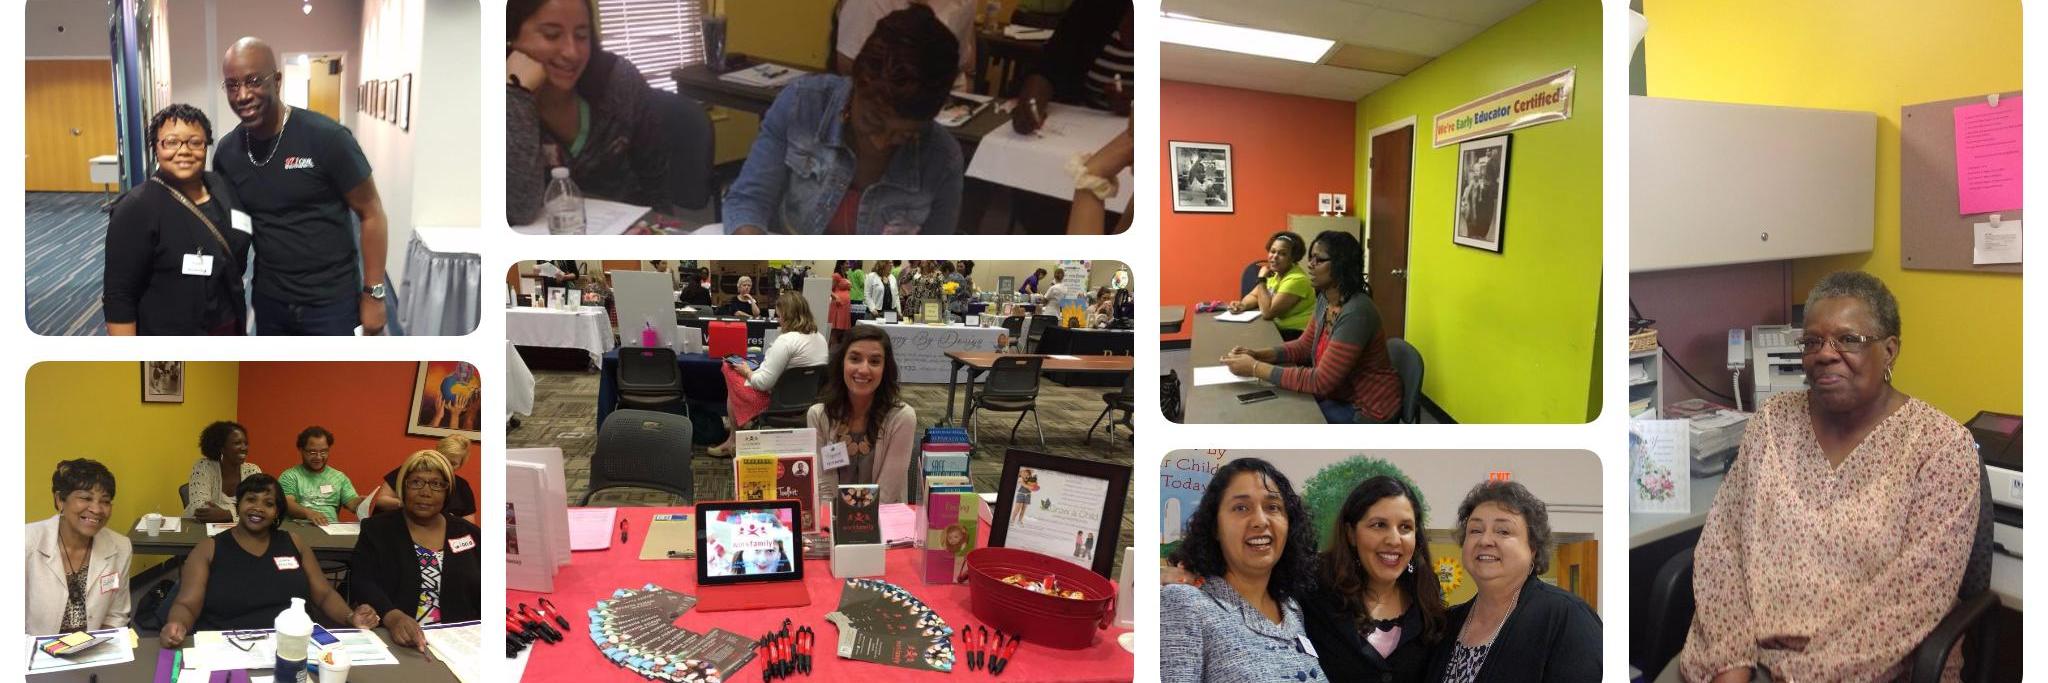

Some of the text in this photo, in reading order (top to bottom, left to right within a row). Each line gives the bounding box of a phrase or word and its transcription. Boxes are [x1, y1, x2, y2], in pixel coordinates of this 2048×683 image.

[1436, 123, 1455, 135] We're
[1456, 116, 1472, 129] Early
[1474, 105, 1511, 124] Educator
[1176, 458, 1219, 475] Child
